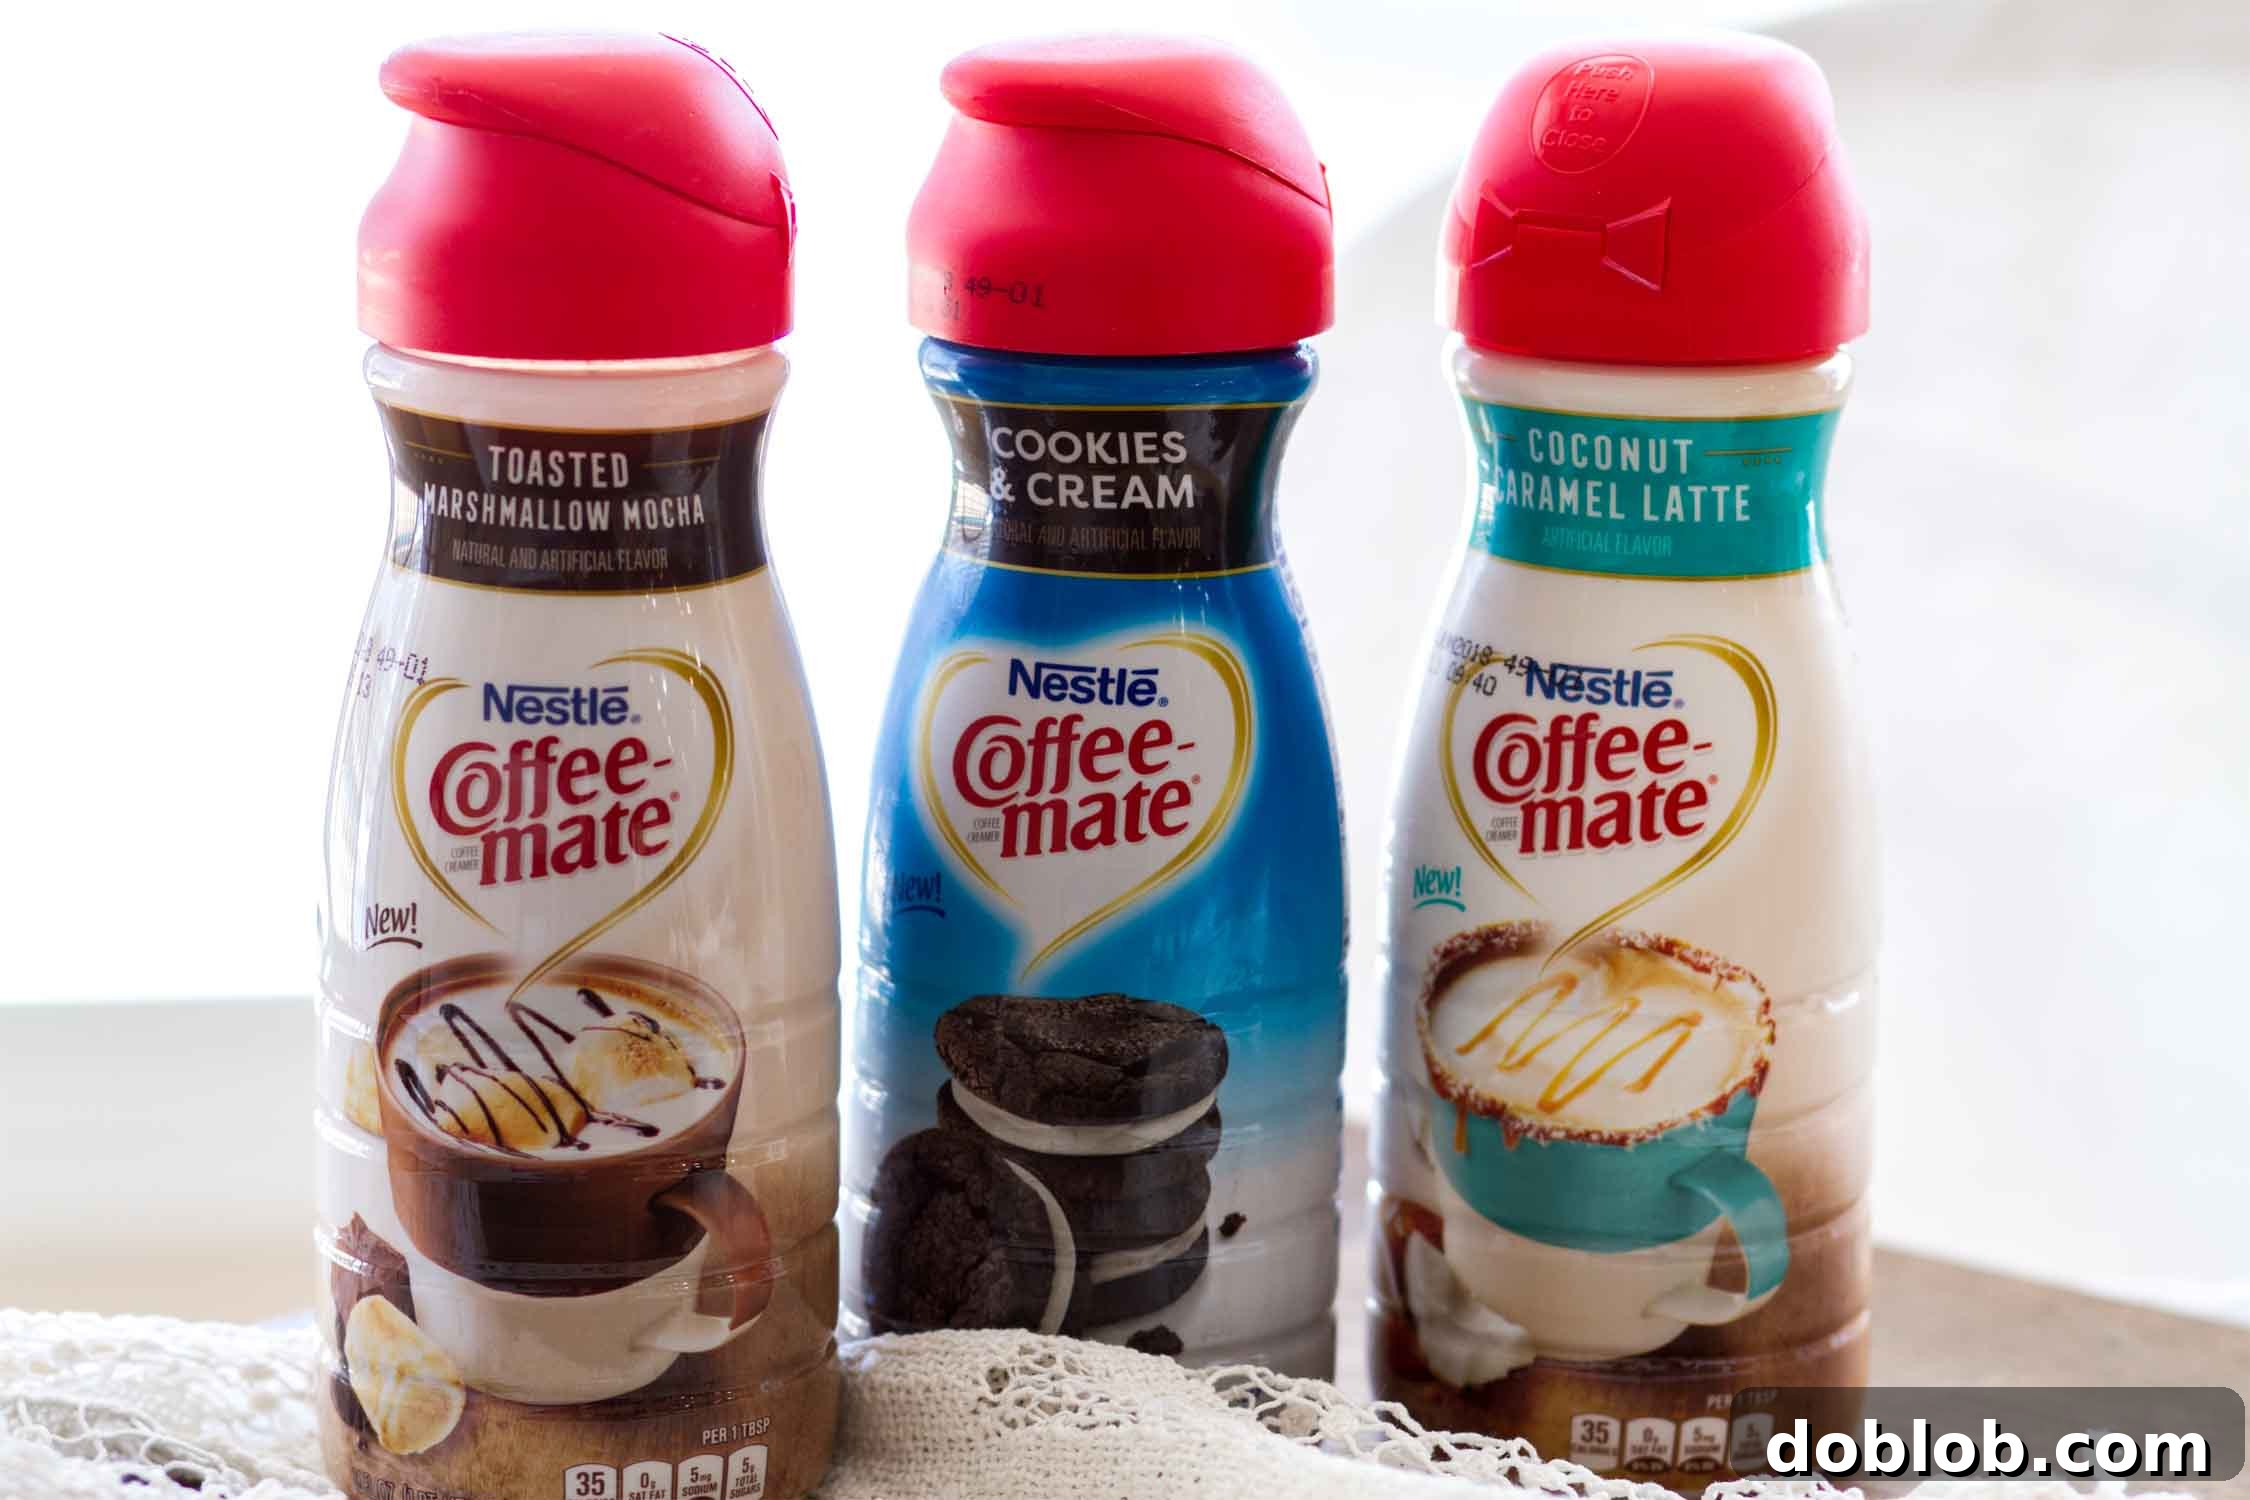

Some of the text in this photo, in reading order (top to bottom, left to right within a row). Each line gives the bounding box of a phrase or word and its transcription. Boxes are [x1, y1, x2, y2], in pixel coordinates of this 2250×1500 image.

[1574, 62, 1633, 81] Push
[1563, 79, 1619, 104] Here
[1568, 103, 1594, 122] to
[1541, 126, 1608, 153] Close
[990, 426, 1188, 466] COOKIES
[1527, 427, 1693, 475] COCONUT
[487, 444, 630, 489] TOASTED
[989, 467, 1195, 510] & CREAM
[1494, 465, 1751, 523] CARAMEL LATTE
[423, 481, 705, 531] MARSHMALLOW MOCHA
[451, 538, 669, 572] NATURAL AND ARTIFICIAL FLAVOR
[1541, 525, 1672, 557] ARTIFICIAL FLAVOR
[999, 779, 1192, 858] mate
[1518, 778, 1709, 854] mate
[479, 796, 672, 886] mate
[1413, 864, 1462, 899] New!
[365, 902, 418, 940] New!
[702, 1416, 771, 1445] PER 1 TBSP
[1580, 1419, 1610, 1445] 35
[575, 1471, 606, 1497] 35
[639, 1471, 656, 1490] 0g
[681, 1482, 718, 1497] SODIUM
